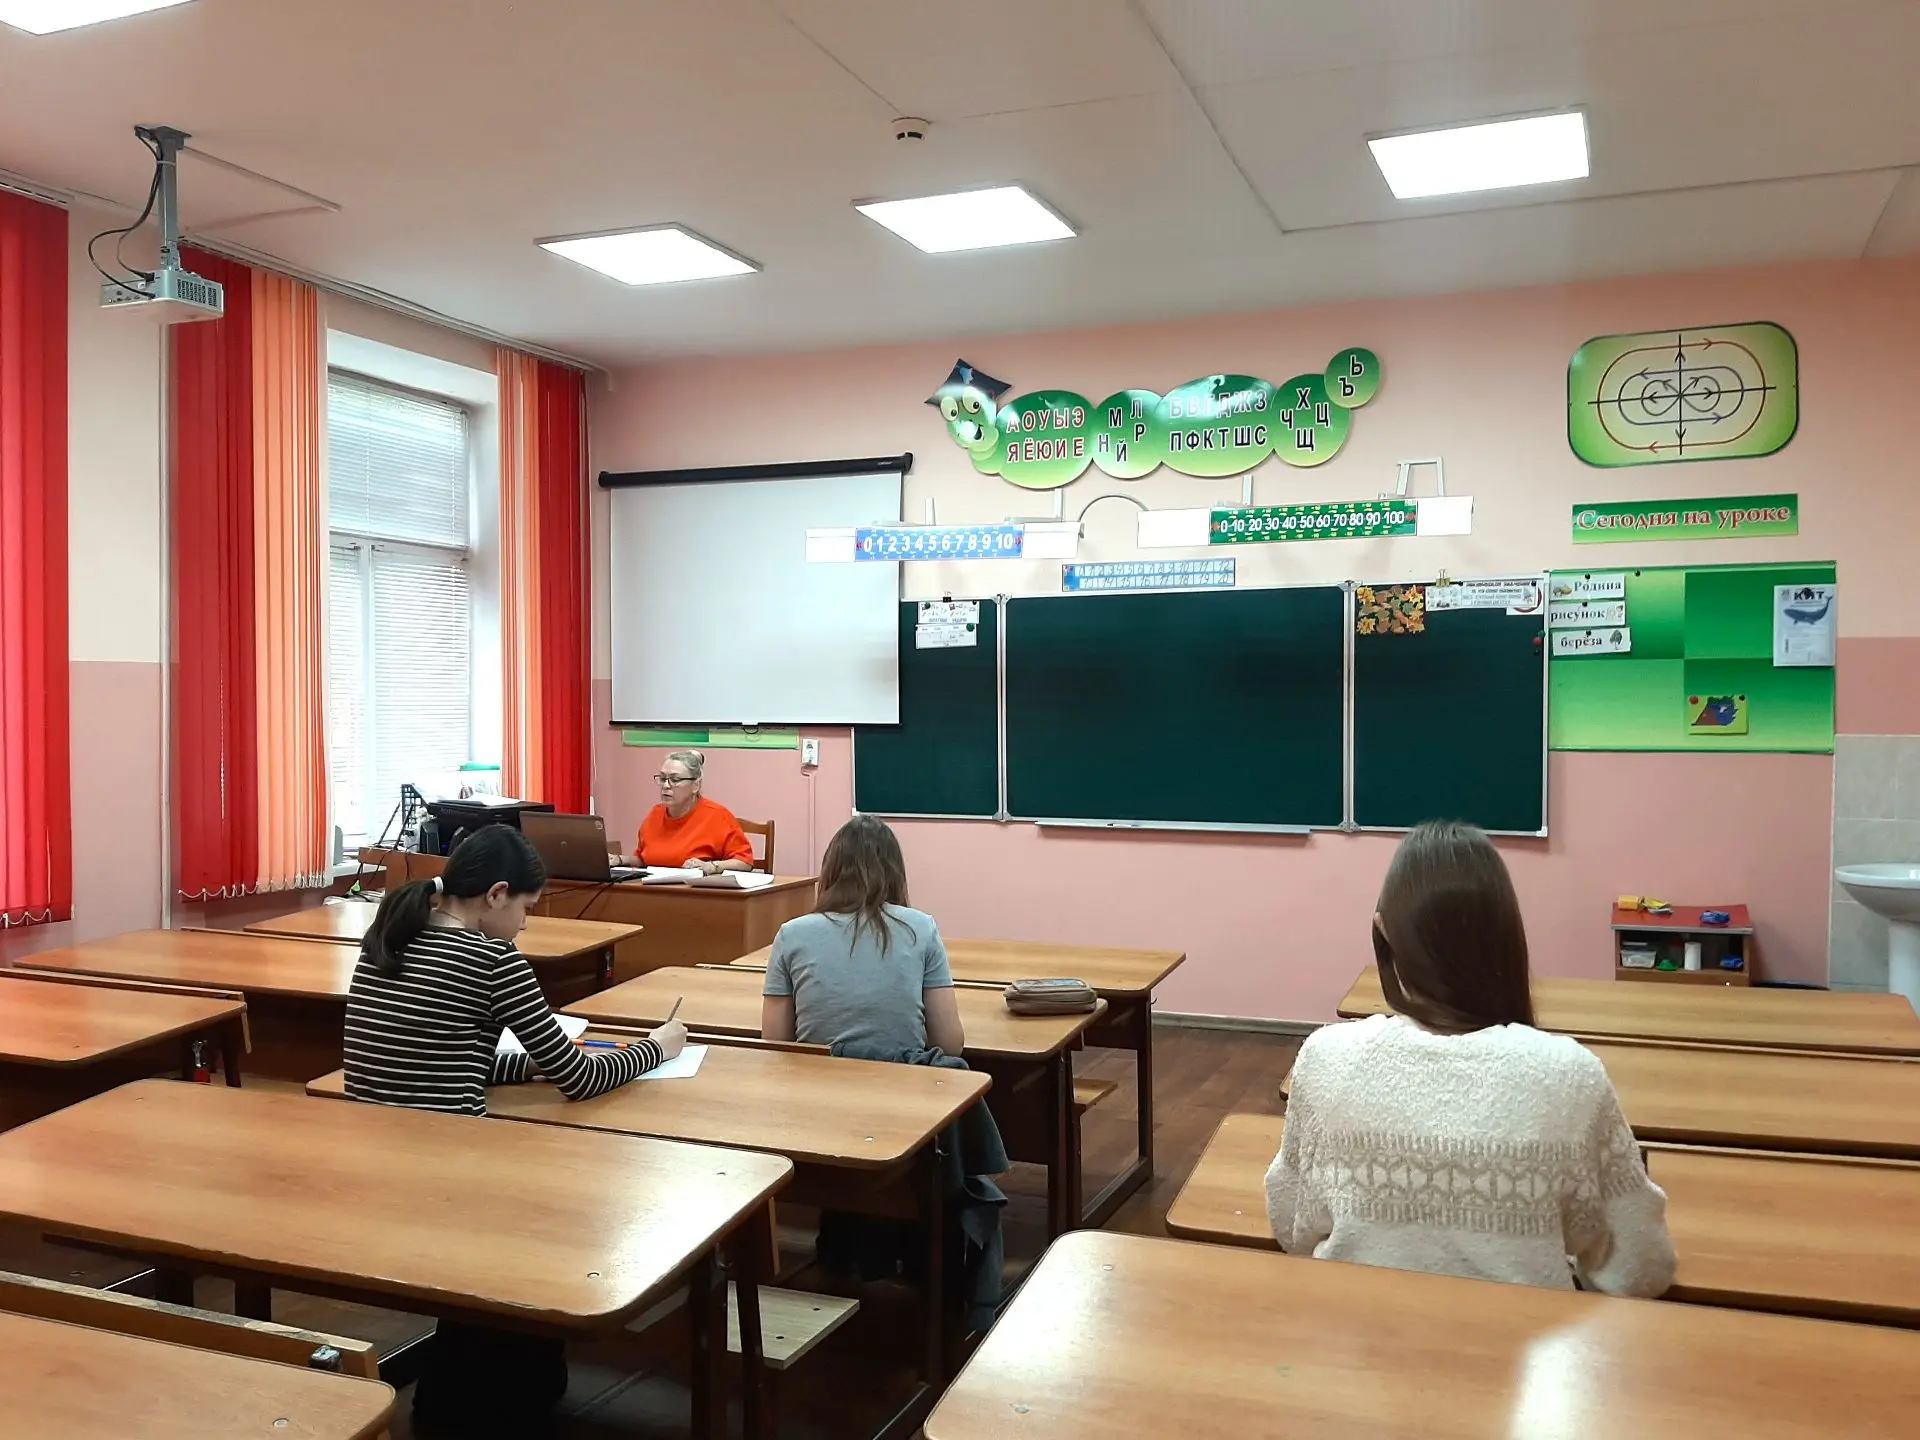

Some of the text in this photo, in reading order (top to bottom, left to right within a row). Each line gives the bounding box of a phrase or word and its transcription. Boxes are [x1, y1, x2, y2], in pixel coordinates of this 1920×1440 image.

[1350, 354, 1364, 377] Ь
[1338, 376, 1355, 398] Ъ
[1296, 387, 1311, 410] Х
[1280, 402, 1330, 430] Ч Ц
[1134, 423, 1145, 442] Р
[1296, 428, 1315, 453] Щ
[1098, 434, 1127, 463] Н Й
[1220, 511, 1404, 533] 0 10 20 30 40 50 60 70 80 90 100
[1577, 506, 1790, 529] Сегодня на уроке
[864, 533, 1014, 553] 0 1 2 3 4 5 6 7 8 9 10
[1574, 581, 1621, 592] Родина
[1551, 609, 1605, 622] рисунок
[1561, 636, 1602, 649] берёза
